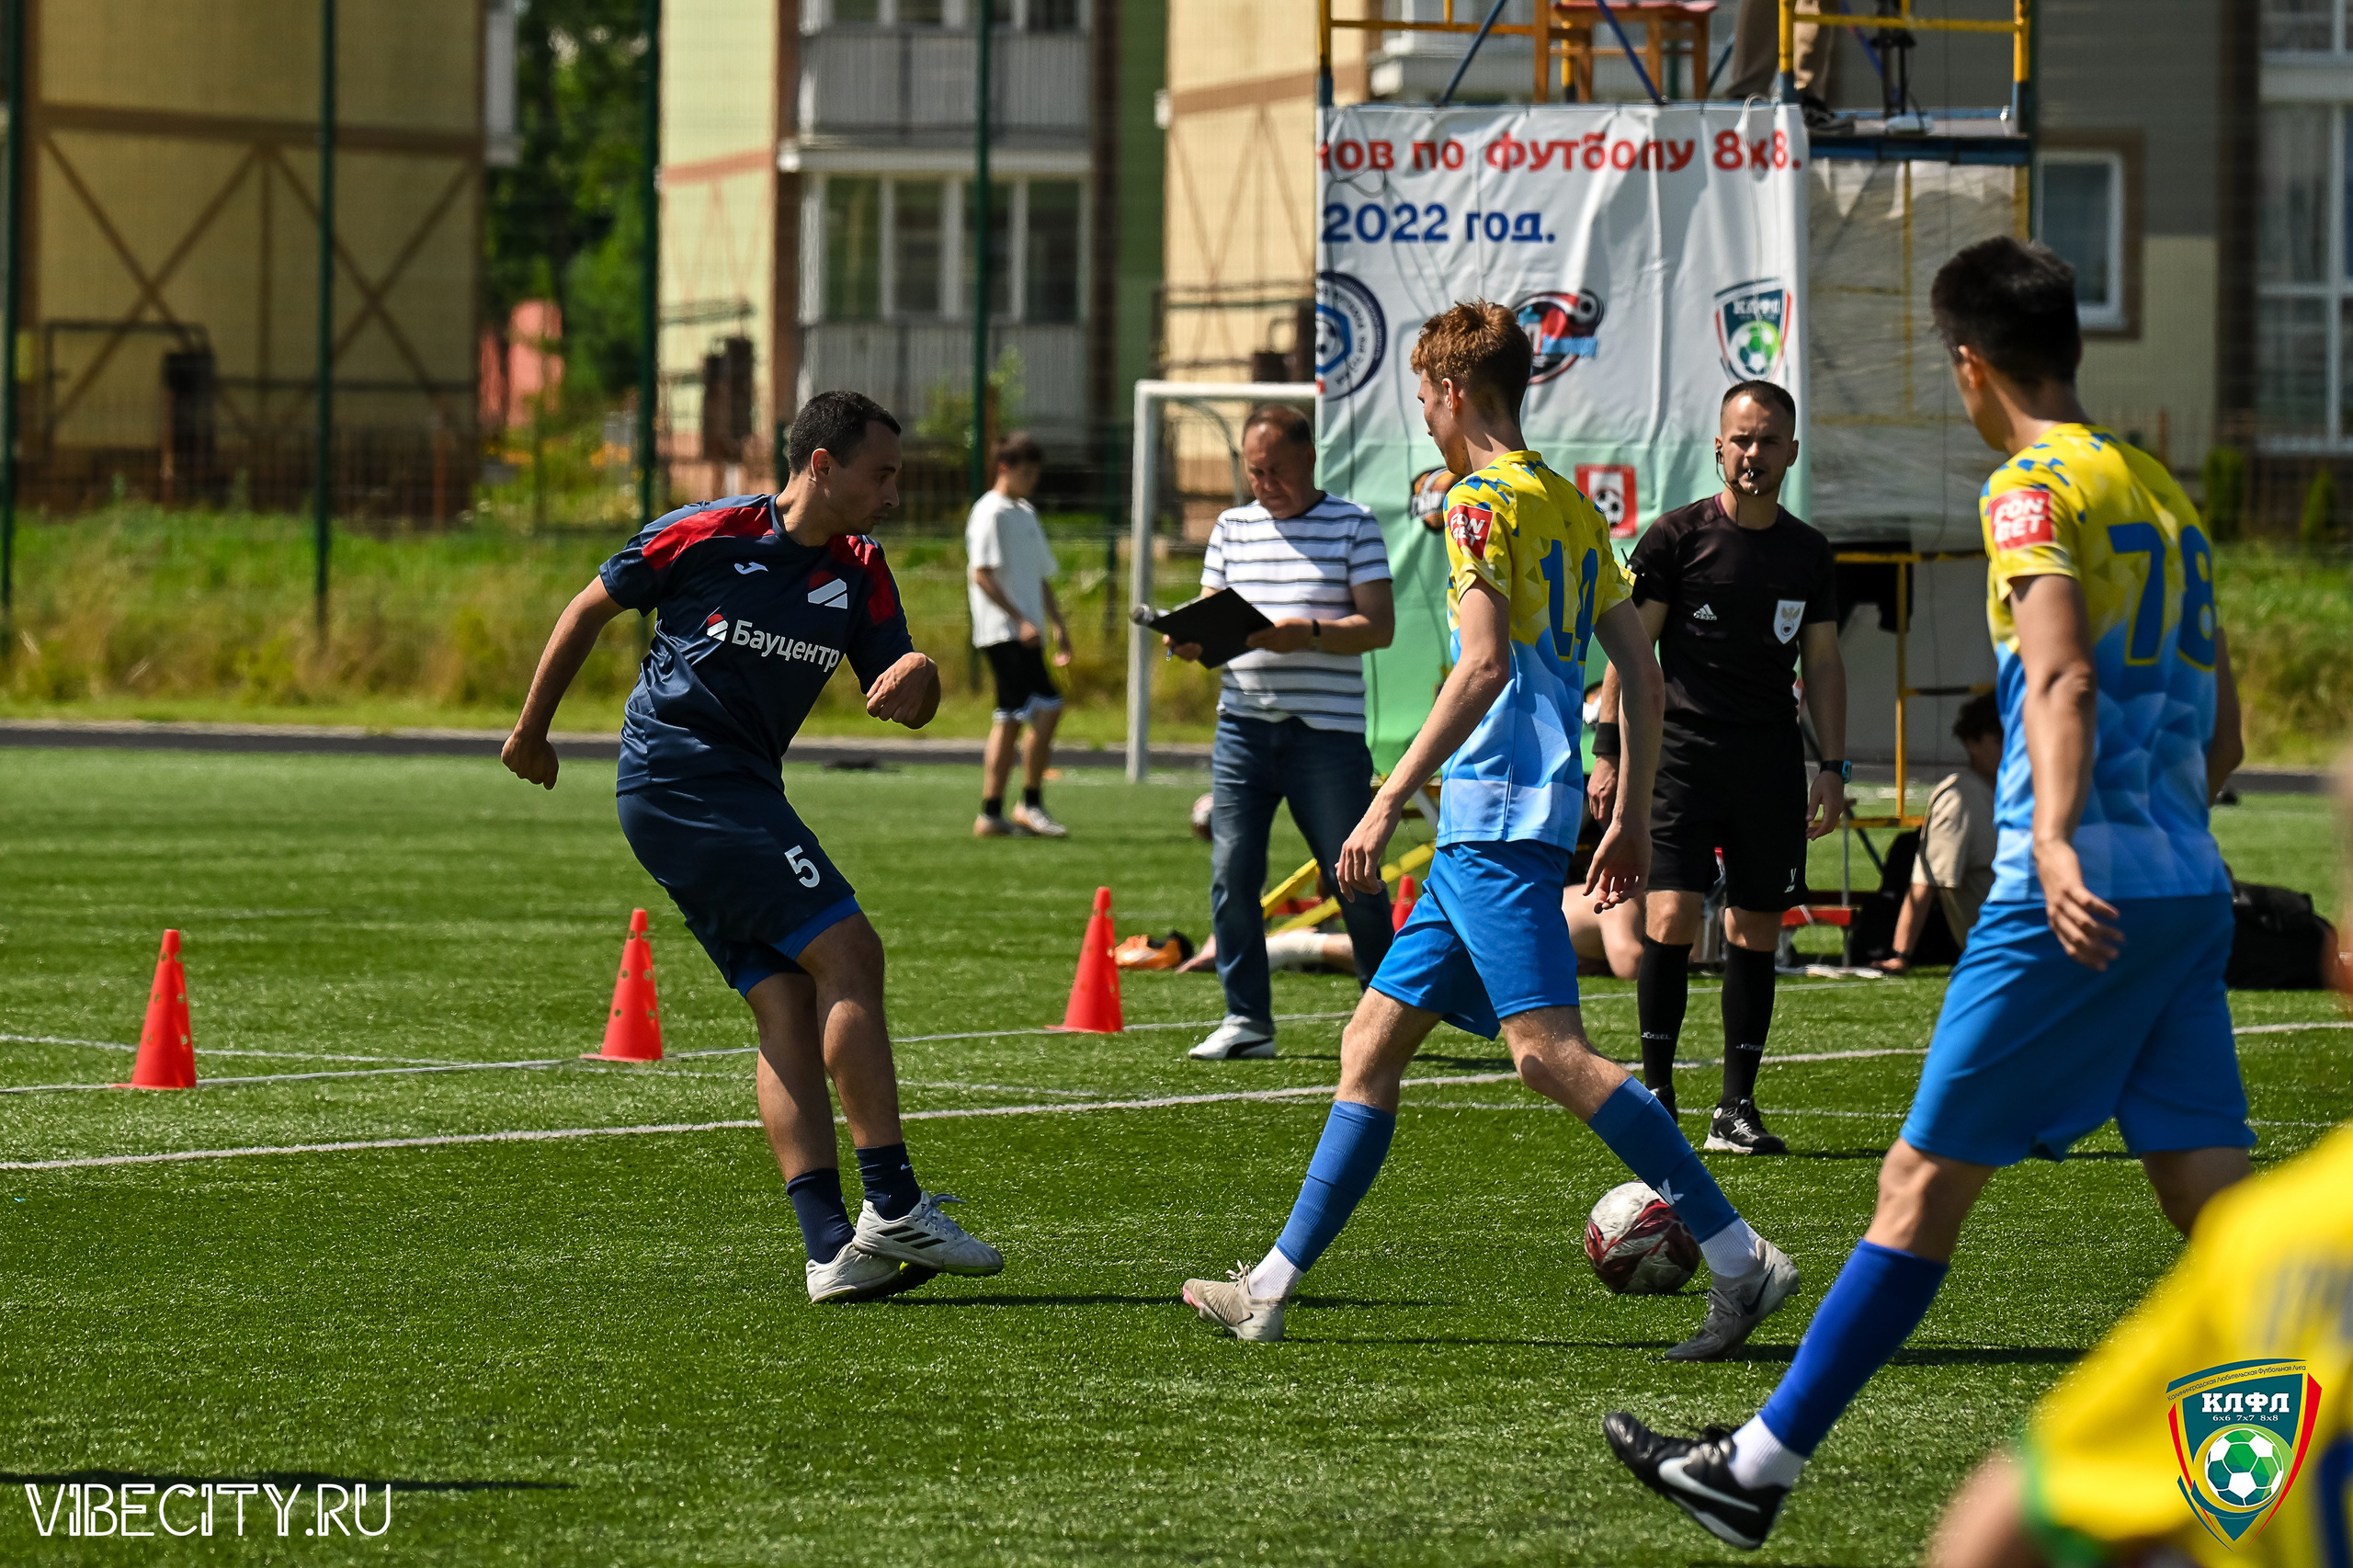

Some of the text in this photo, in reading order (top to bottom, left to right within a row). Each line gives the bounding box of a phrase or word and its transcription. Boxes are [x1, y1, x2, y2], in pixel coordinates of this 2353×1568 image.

[1412, 140, 1465, 171] по
[1484, 131, 1695, 173] футболу
[1322, 202, 1556, 244] 2022 год.
[1450, 512, 1485, 533] FON
[1994, 497, 2044, 524] FON
[1995, 515, 2046, 542] BET
[2107, 521, 2216, 672] 78
[732, 619, 841, 672] Бауцентр
[784, 845, 821, 888] 5
